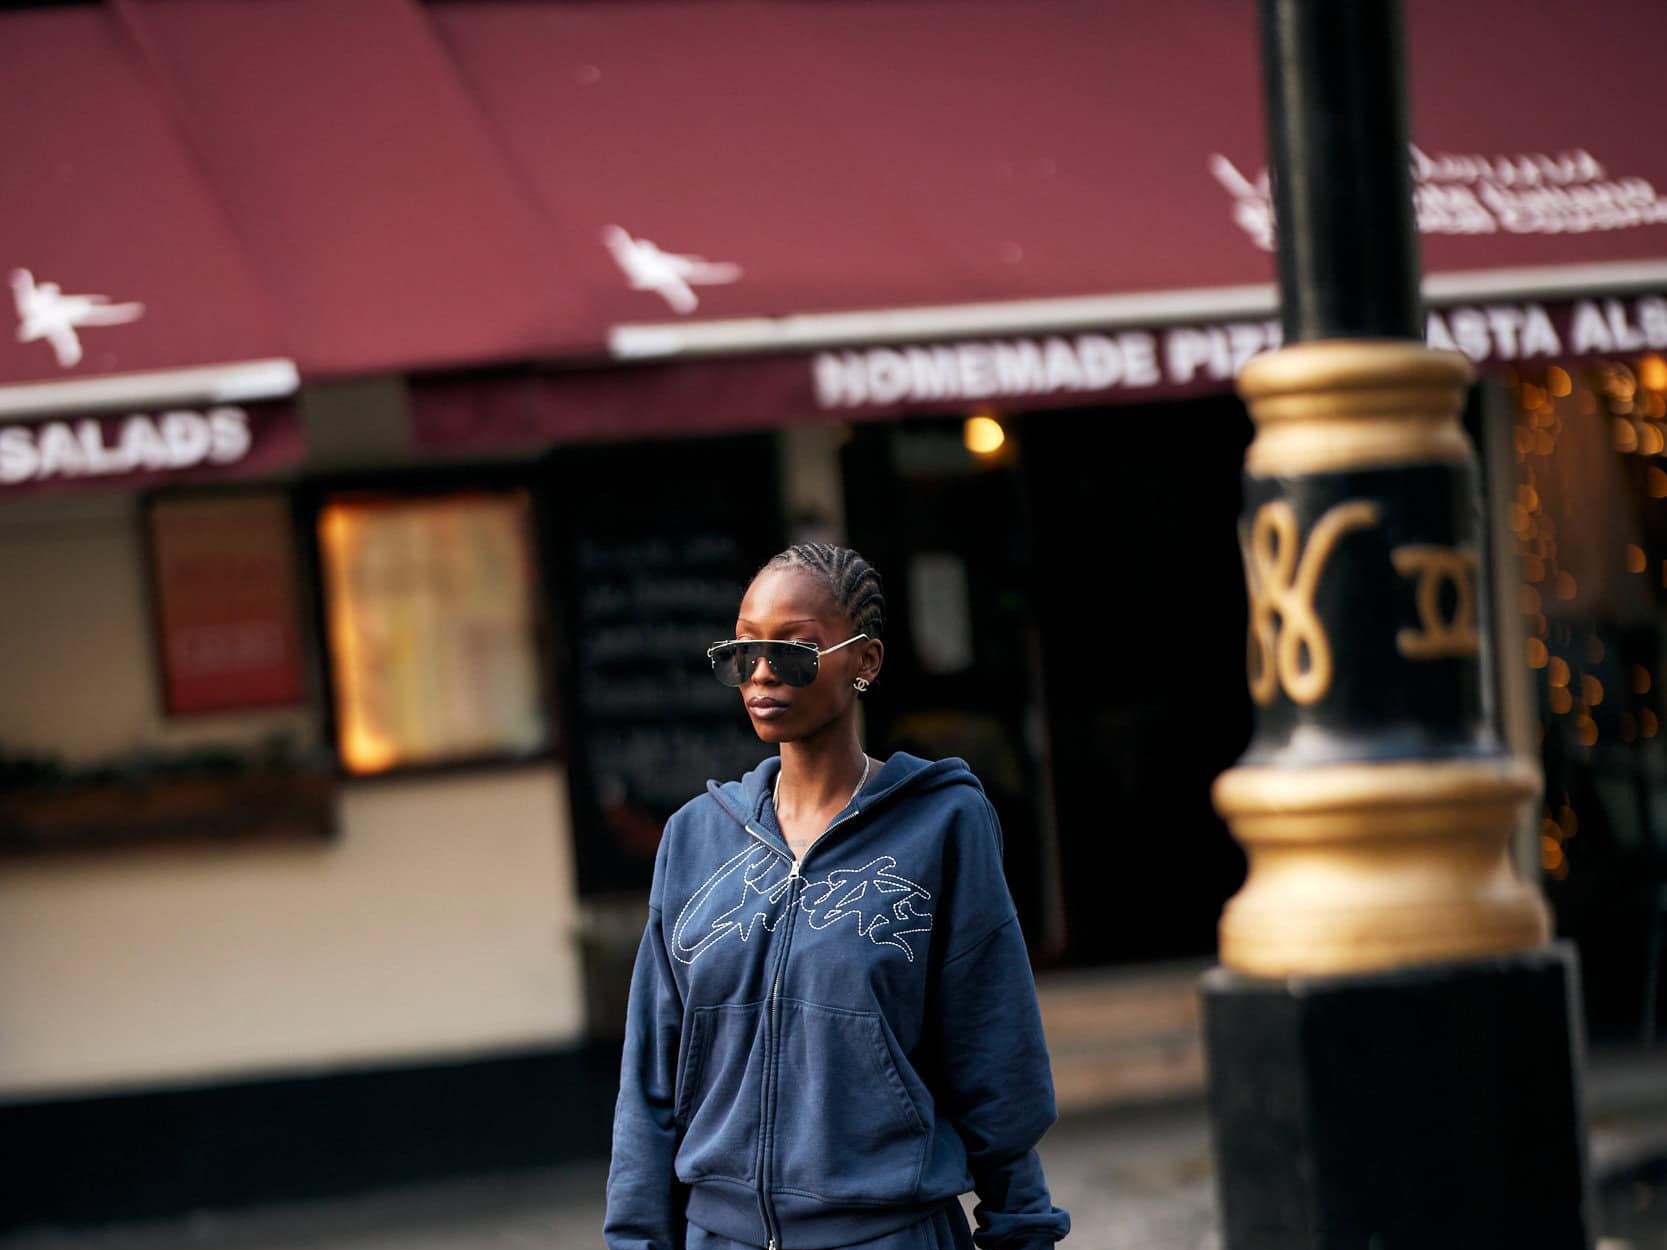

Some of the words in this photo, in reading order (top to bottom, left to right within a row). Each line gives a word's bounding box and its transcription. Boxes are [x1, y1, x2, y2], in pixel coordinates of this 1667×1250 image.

[815, 330, 1160, 406] HOMEMADE
[1426, 306, 1559, 361] ASTA
[0, 407, 250, 483] SALADS
